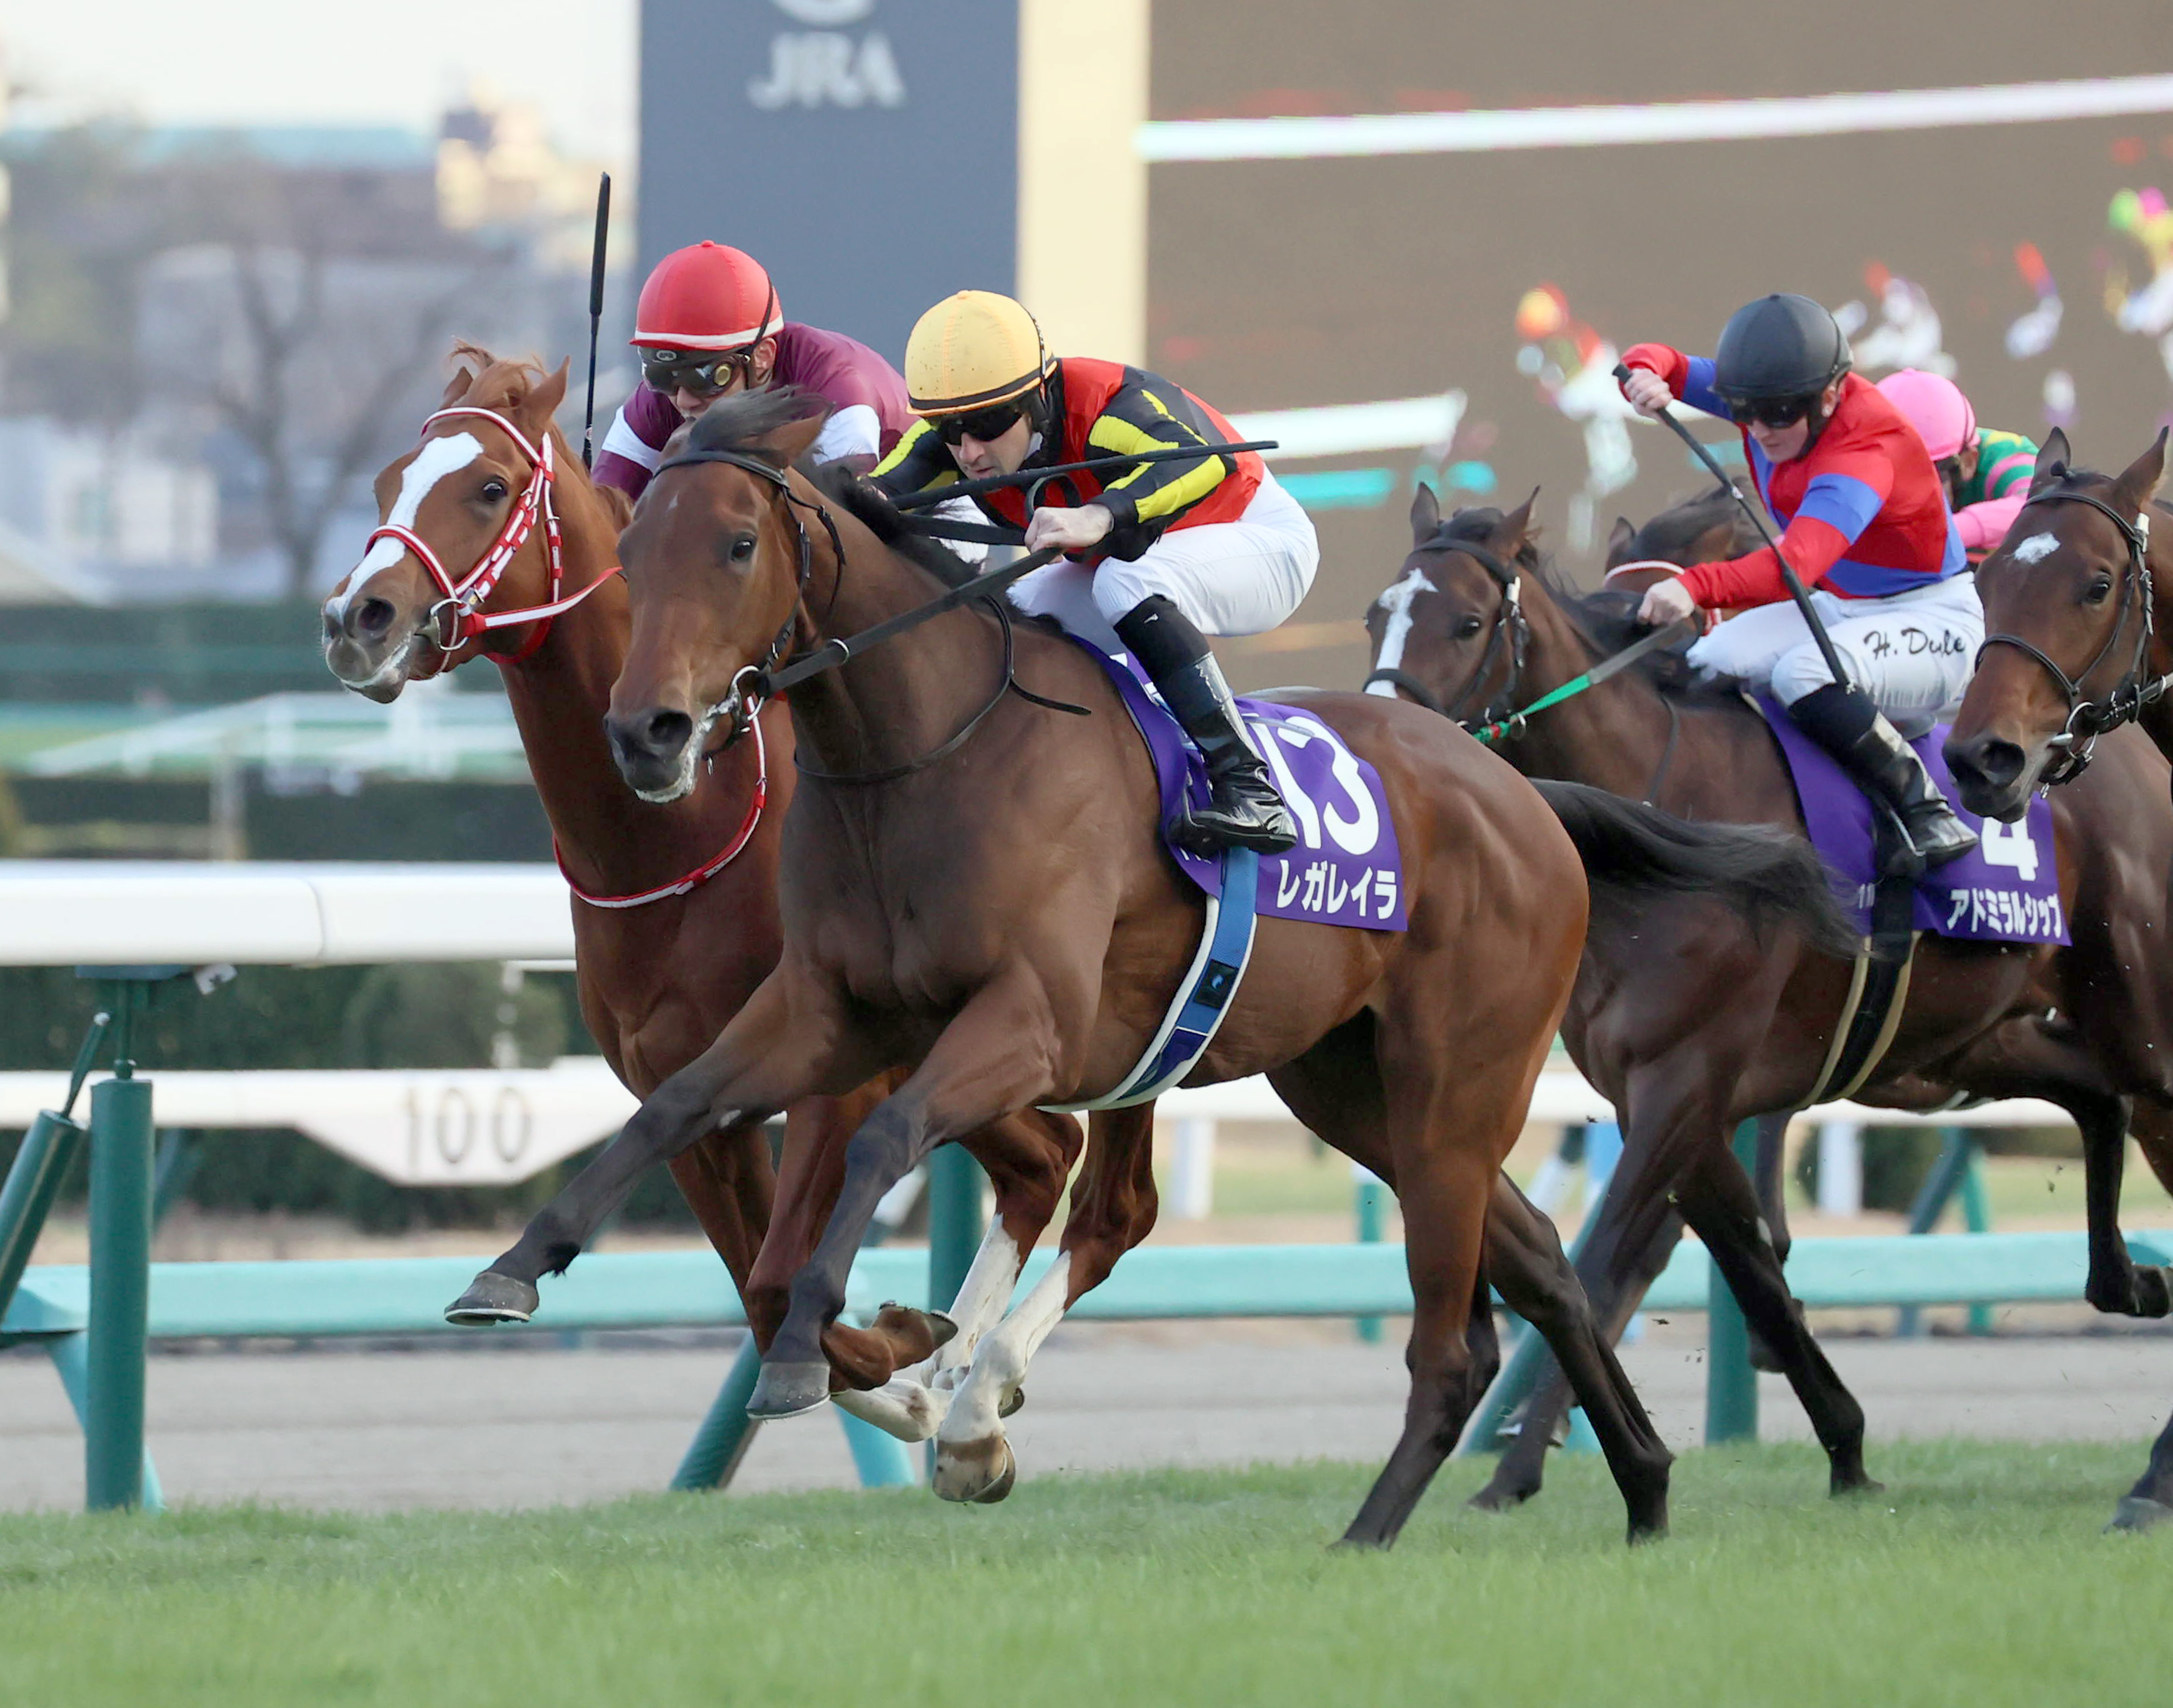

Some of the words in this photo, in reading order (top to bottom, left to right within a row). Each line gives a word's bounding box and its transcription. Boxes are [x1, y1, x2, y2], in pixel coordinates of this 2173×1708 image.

[747, 31, 906, 111] JRA
[1277, 859, 1397, 920] レガレイラ
[403, 1086, 531, 1176] 100
